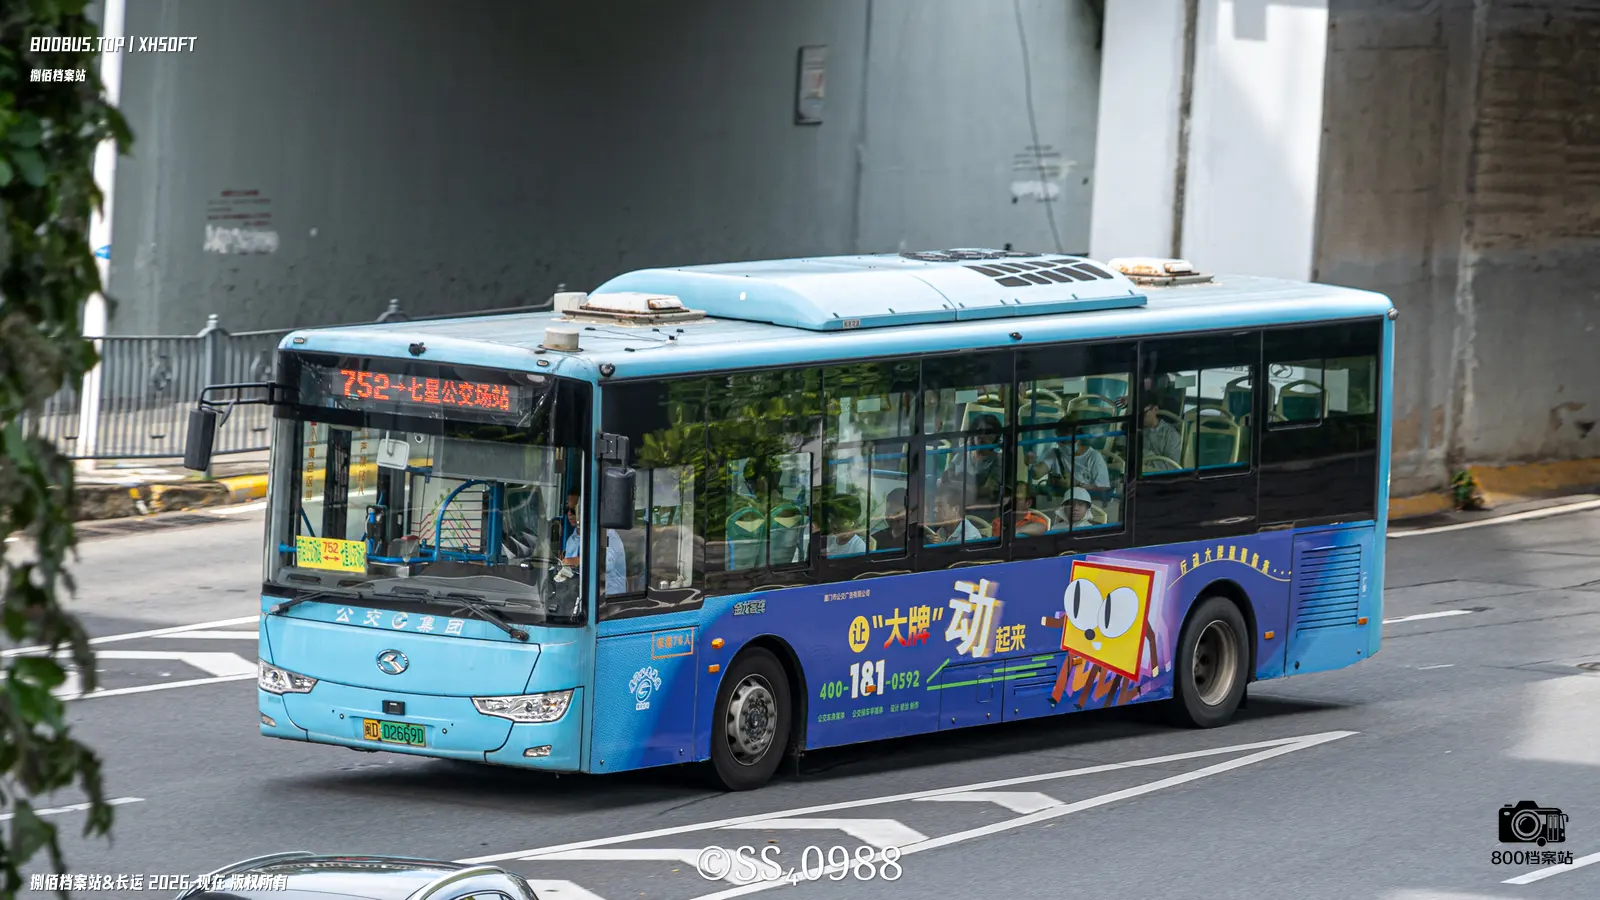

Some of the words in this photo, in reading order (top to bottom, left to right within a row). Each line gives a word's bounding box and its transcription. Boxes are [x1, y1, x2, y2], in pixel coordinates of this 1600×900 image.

[340, 369, 390, 400] 752
[407, 377, 509, 411] 七星公交场站
[322, 541, 339, 554] 752
[733, 599, 766, 616] 金龙客车
[819, 659, 920, 700] 400-181-0592
